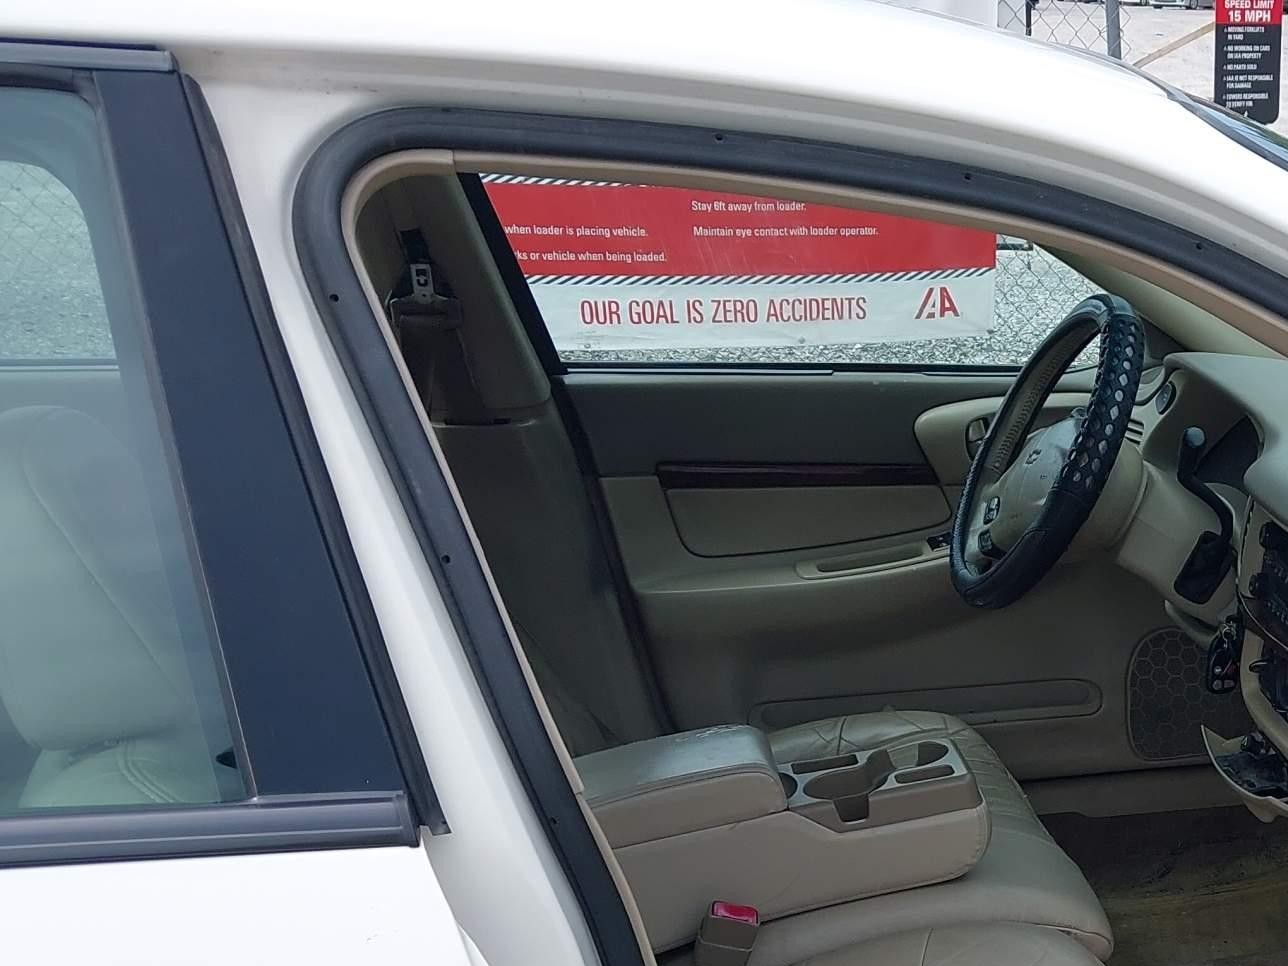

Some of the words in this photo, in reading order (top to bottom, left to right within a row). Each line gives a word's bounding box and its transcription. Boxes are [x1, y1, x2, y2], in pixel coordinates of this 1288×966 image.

[1224, 0, 1251, 9] SPEED
[1253, 0, 1274, 9] LIMIT
[1228, 10, 1241, 22] 15
[1245, 10, 1271, 23] MPH
[691, 200, 712, 213] Stay
[713, 201, 726, 211] 6ft
[727, 202, 752, 213] away
[754, 201, 774, 212] from
[776, 201, 807, 212] loader.
[505, 224, 532, 235] when
[533, 225, 563, 236] loader
[565, 226, 575, 236] is
[576, 226, 610, 238] placing
[611, 227, 648, 237] vehicle.
[693, 226, 733, 236] Maintain
[735, 228, 751, 238] eye
[754, 226, 787, 237] contact
[789, 225, 808, 236] with
[809, 226, 837, 236] loader
[839, 227, 879, 238] operator.
[530, 253, 539, 261] or
[541, 251, 576, 261] vehicle
[578, 251, 604, 262] when
[605, 251, 632, 263] being
[633, 252, 667, 263] loaded.
[580, 300, 622, 325] OUR
[628, 300, 680, 325] GOAL
[686, 300, 704, 324] IS
[711, 299, 758, 324] ZERO
[766, 296, 867, 323] ACCIDENTS
